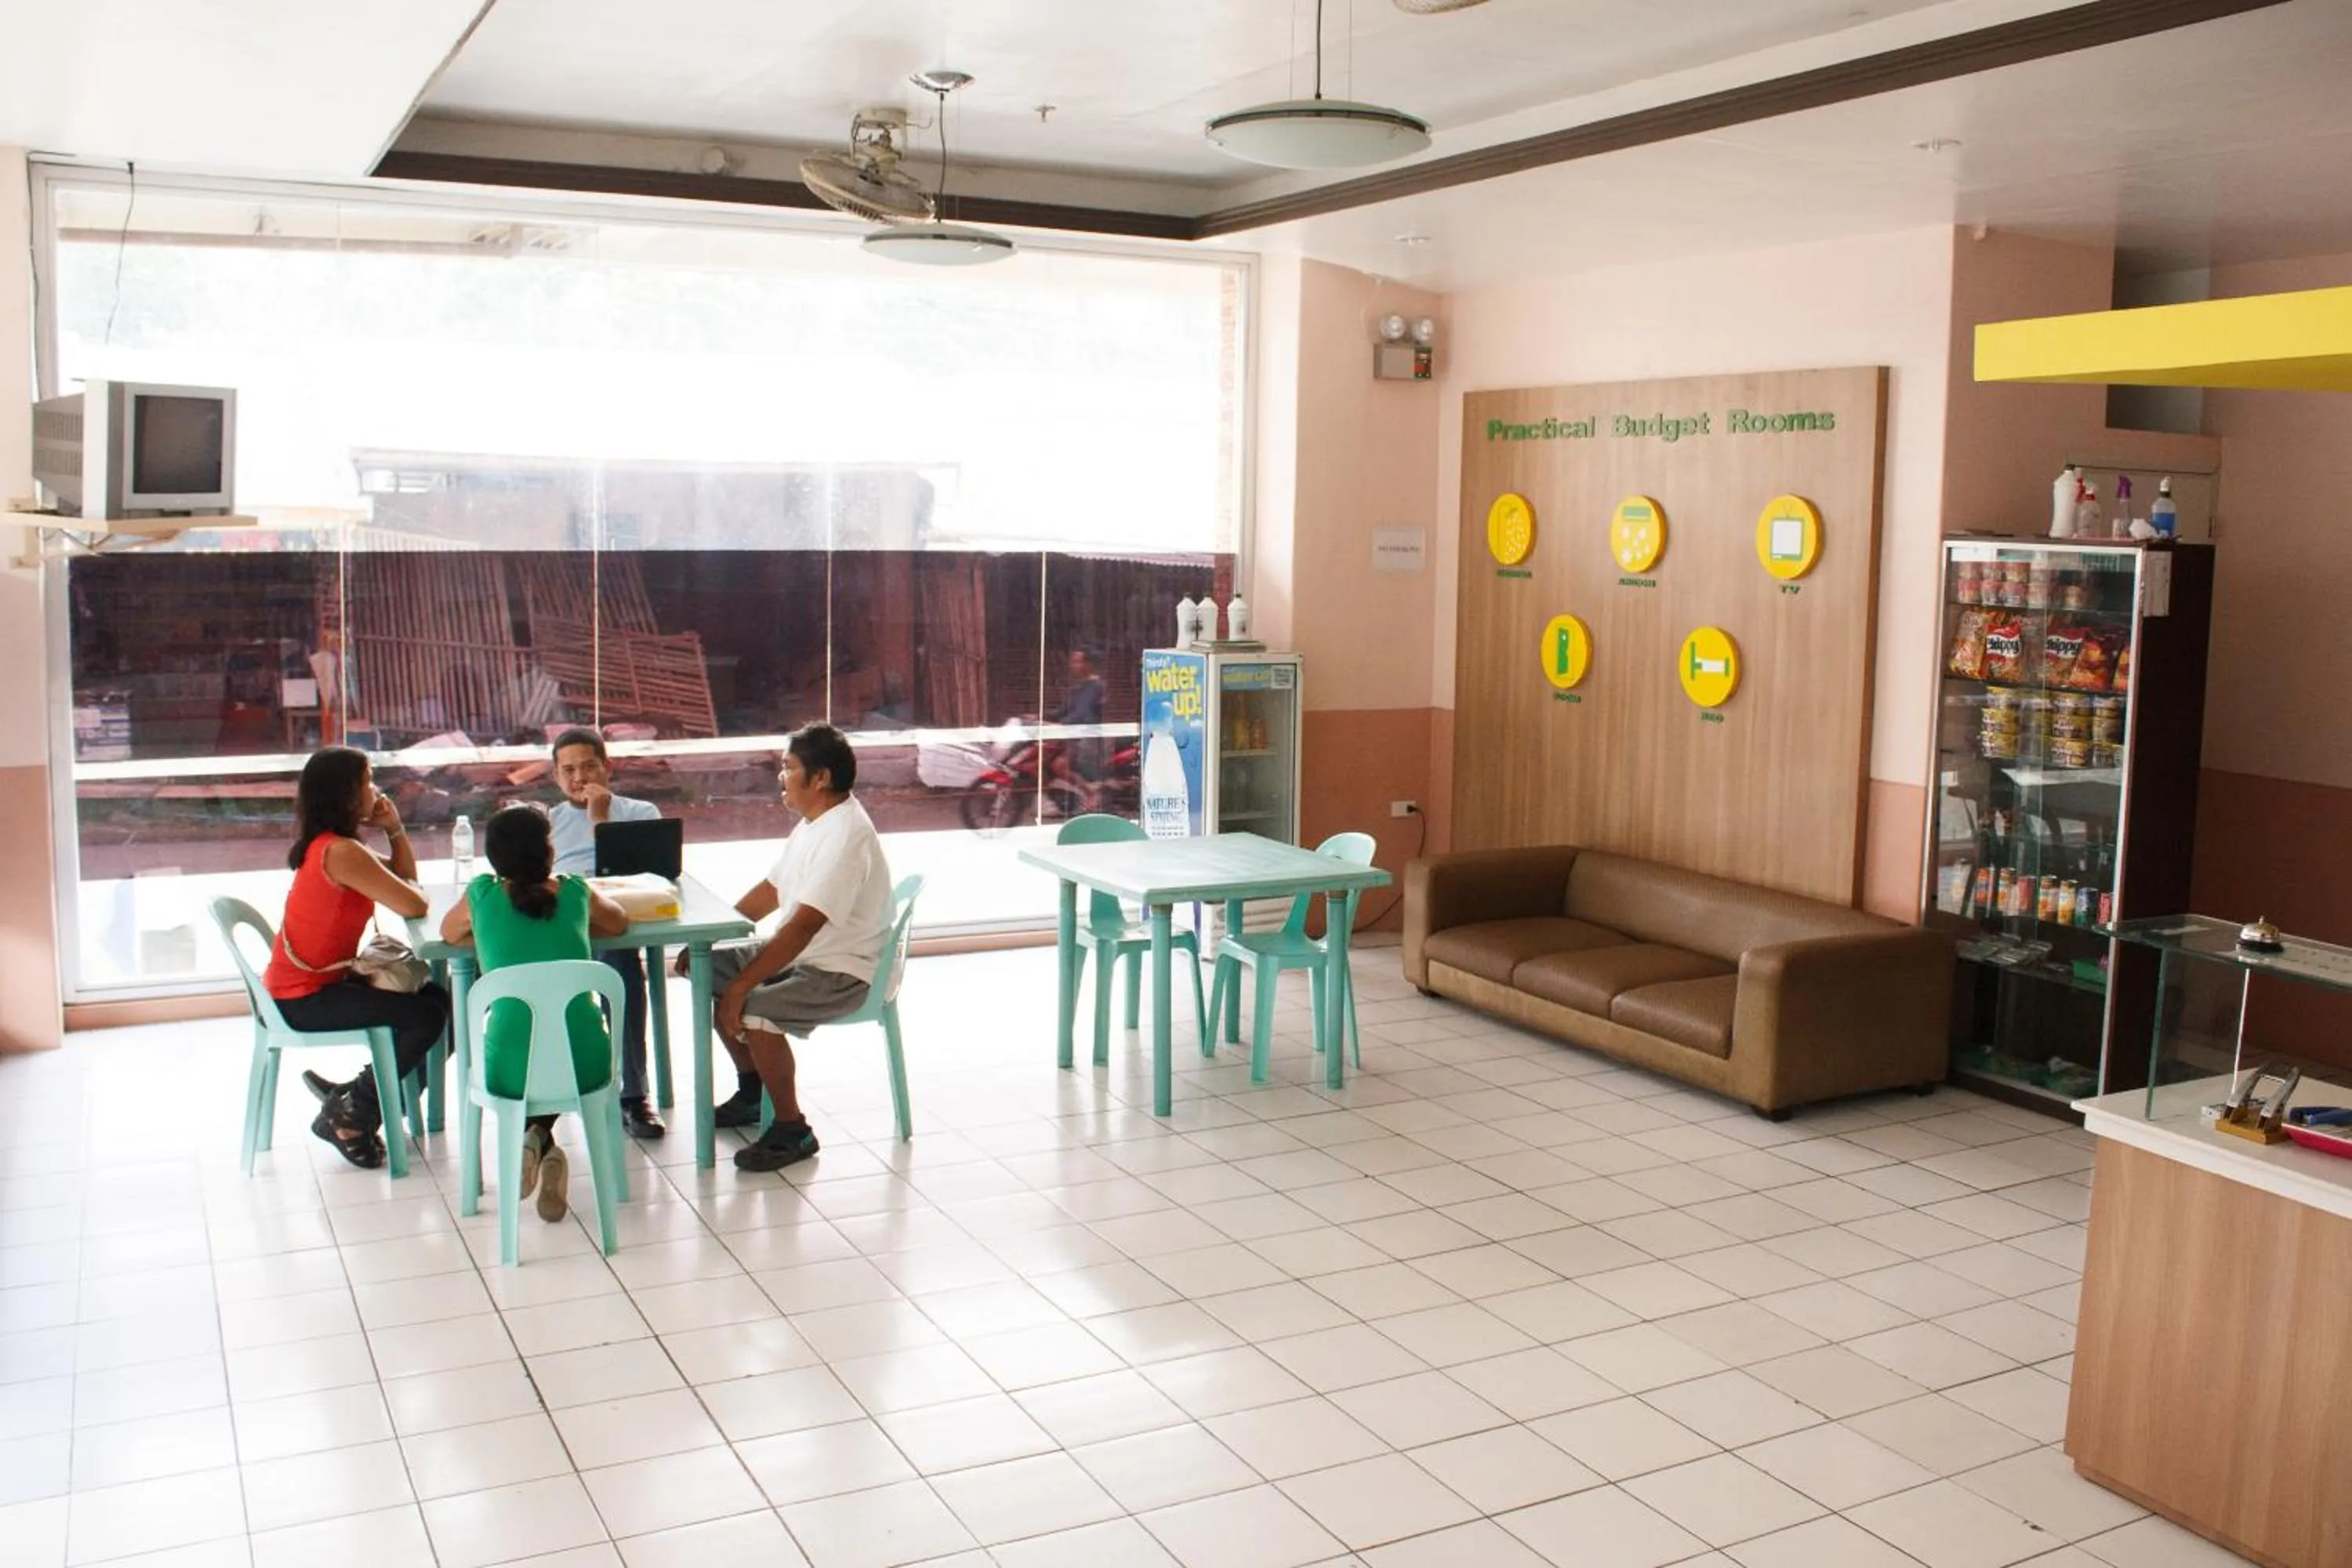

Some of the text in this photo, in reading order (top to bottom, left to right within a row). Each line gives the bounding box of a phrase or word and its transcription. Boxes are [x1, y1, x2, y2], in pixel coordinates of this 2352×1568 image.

[1486, 408, 1835, 442] Practical Budget Rooms
[1146, 662, 1198, 693] water
